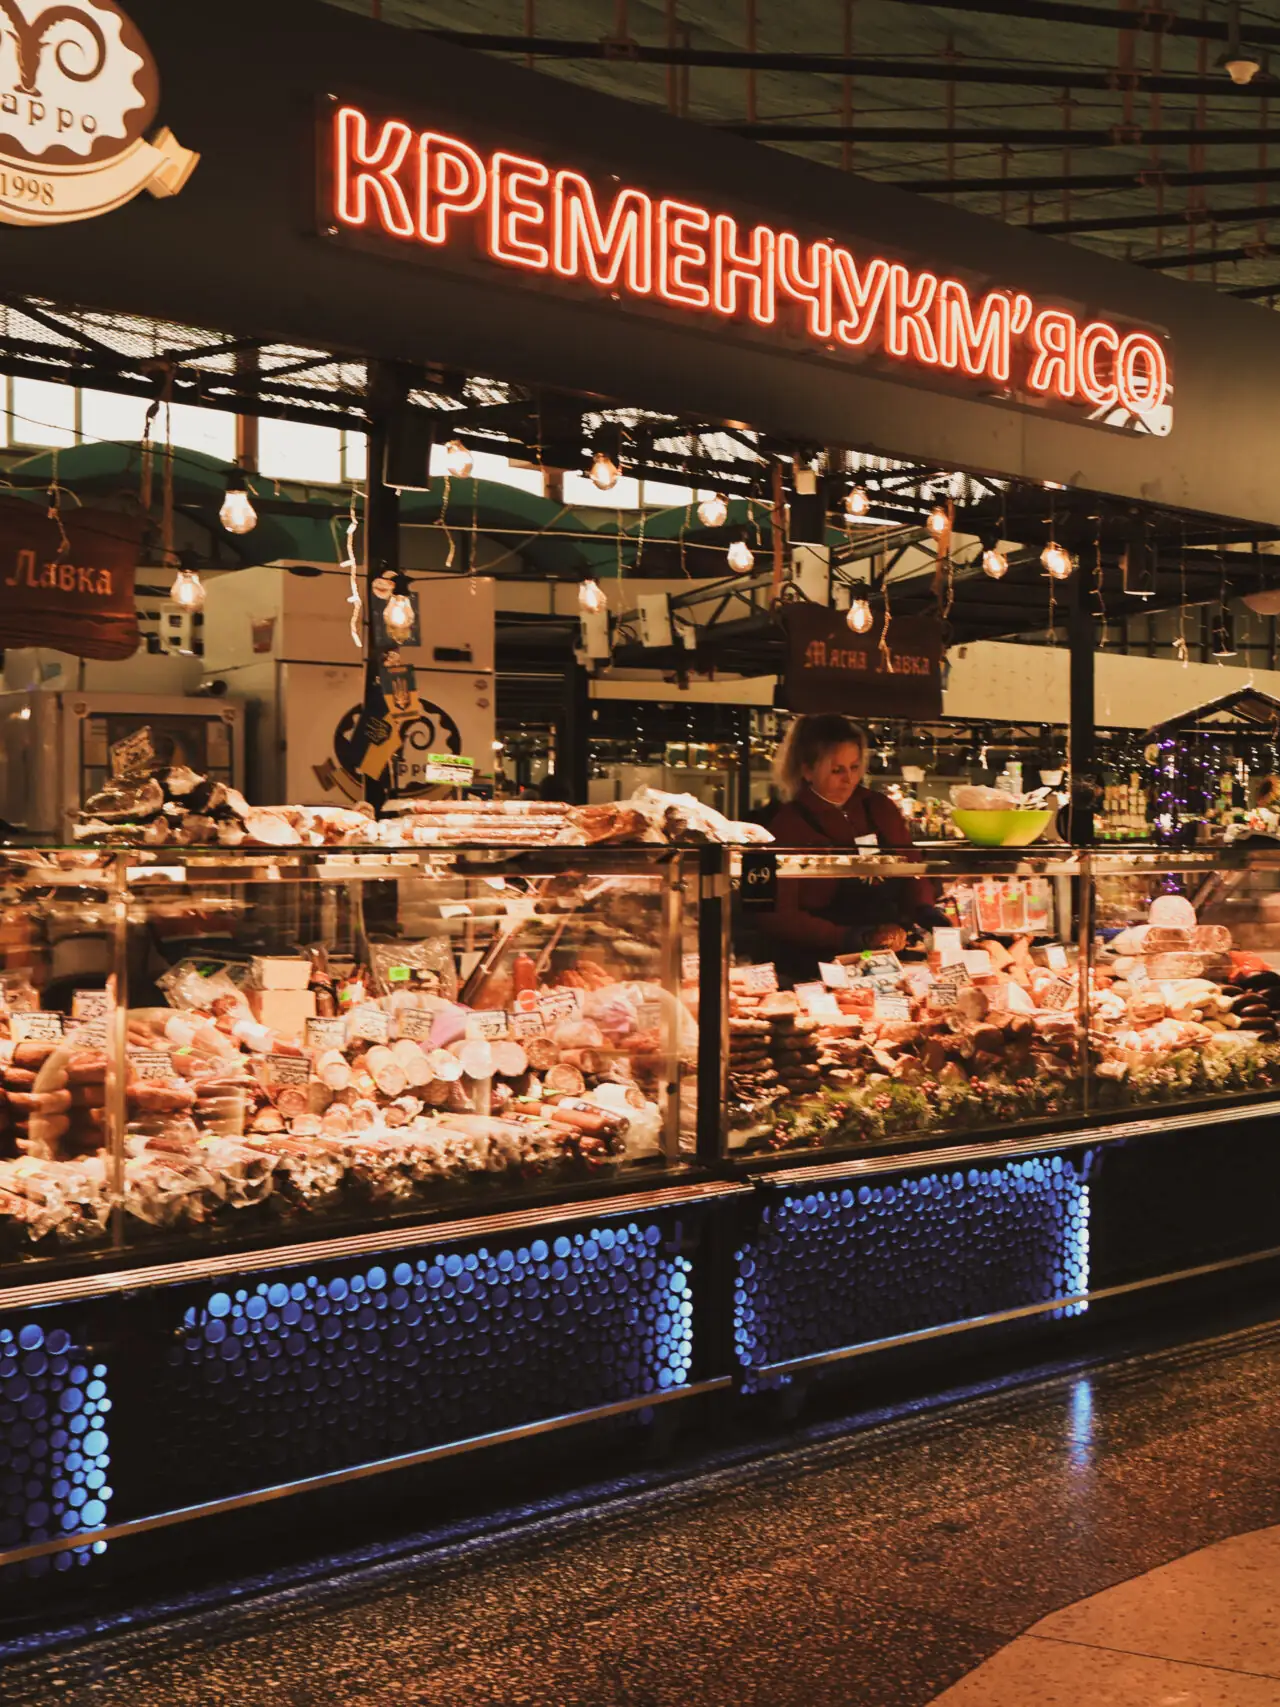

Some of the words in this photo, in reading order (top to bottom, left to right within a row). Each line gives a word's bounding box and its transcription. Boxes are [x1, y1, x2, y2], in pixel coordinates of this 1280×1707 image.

[1, 173, 54, 205] 1998
[335, 106, 1168, 415] КРЕМЕНЧУКМ'ЯСО
[5, 548, 113, 596] Лавка
[747, 867, 771, 885] 6-9
